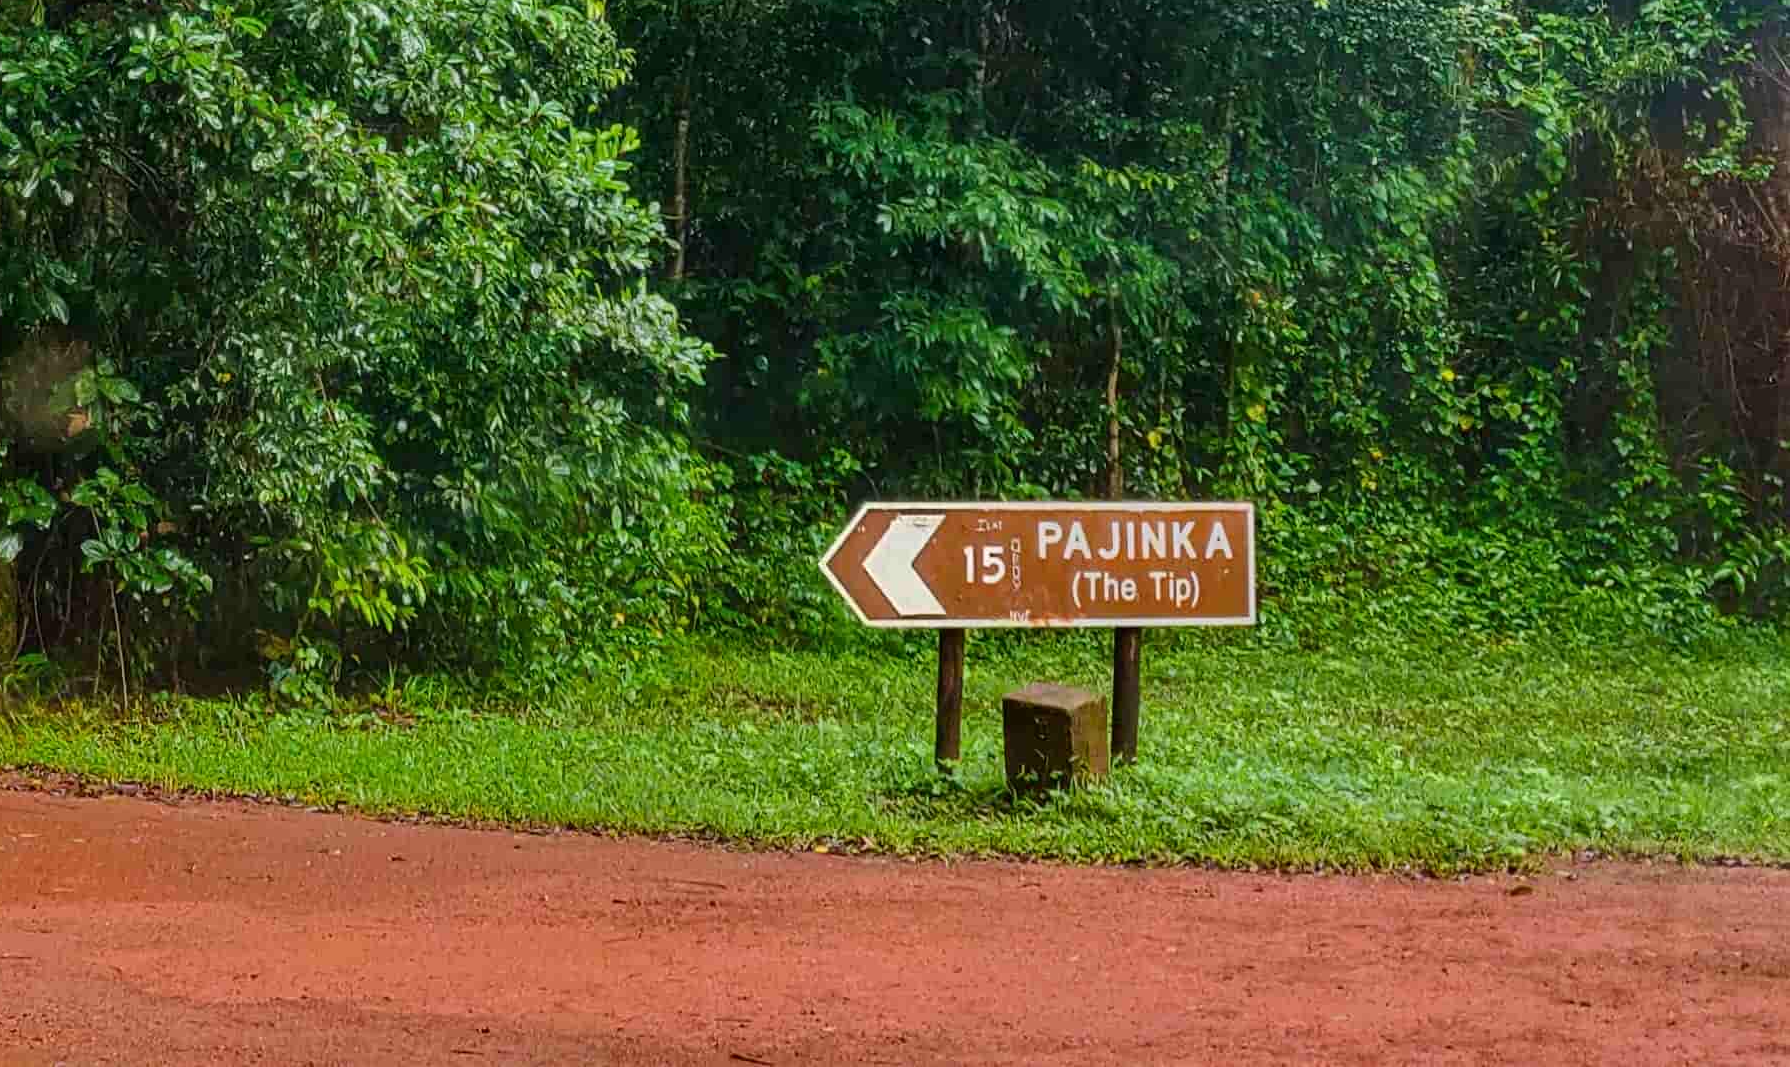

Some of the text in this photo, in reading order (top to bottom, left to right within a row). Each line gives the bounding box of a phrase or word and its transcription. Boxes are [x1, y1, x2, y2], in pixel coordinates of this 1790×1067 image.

[1037, 520, 1234, 561] PAJINKA
[963, 544, 1007, 584] 15
[1072, 571, 1201, 607] (The Tip)
